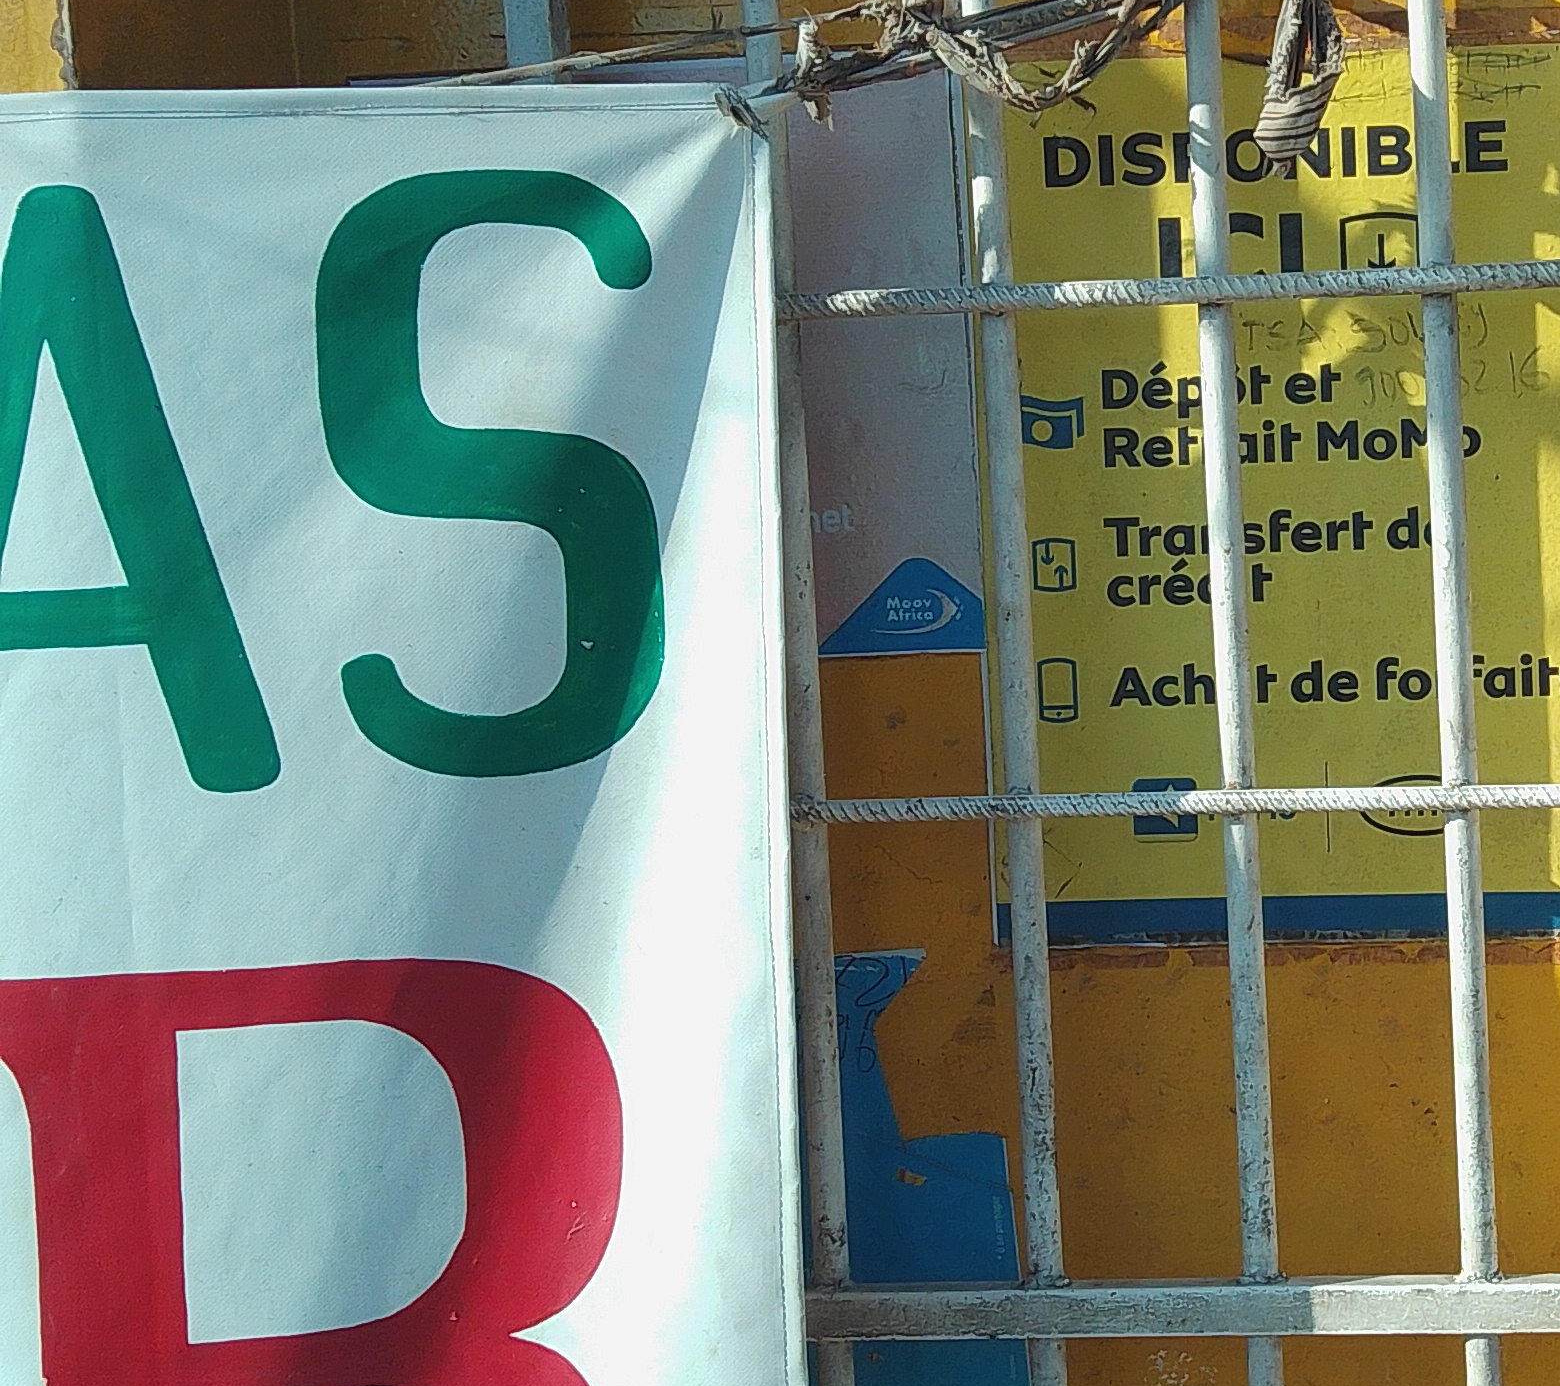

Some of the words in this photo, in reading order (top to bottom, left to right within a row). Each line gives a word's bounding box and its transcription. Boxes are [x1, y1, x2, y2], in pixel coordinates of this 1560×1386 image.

[1043, 120, 1508, 188] DISONIBE
[1101, 360, 1271, 419] Dépt
[1284, 363, 1341, 405] et
[1103, 420, 1302, 469] Retait
[0, 169, 665, 794] AS
[1102, 509, 1374, 557] Trasfert
[886, 596, 932, 609] Moov
[1106, 558, 1273, 607] crét
[888, 609, 934, 622] Africa
[1110, 662, 1278, 707] Acht
[1290, 660, 1359, 703] de
